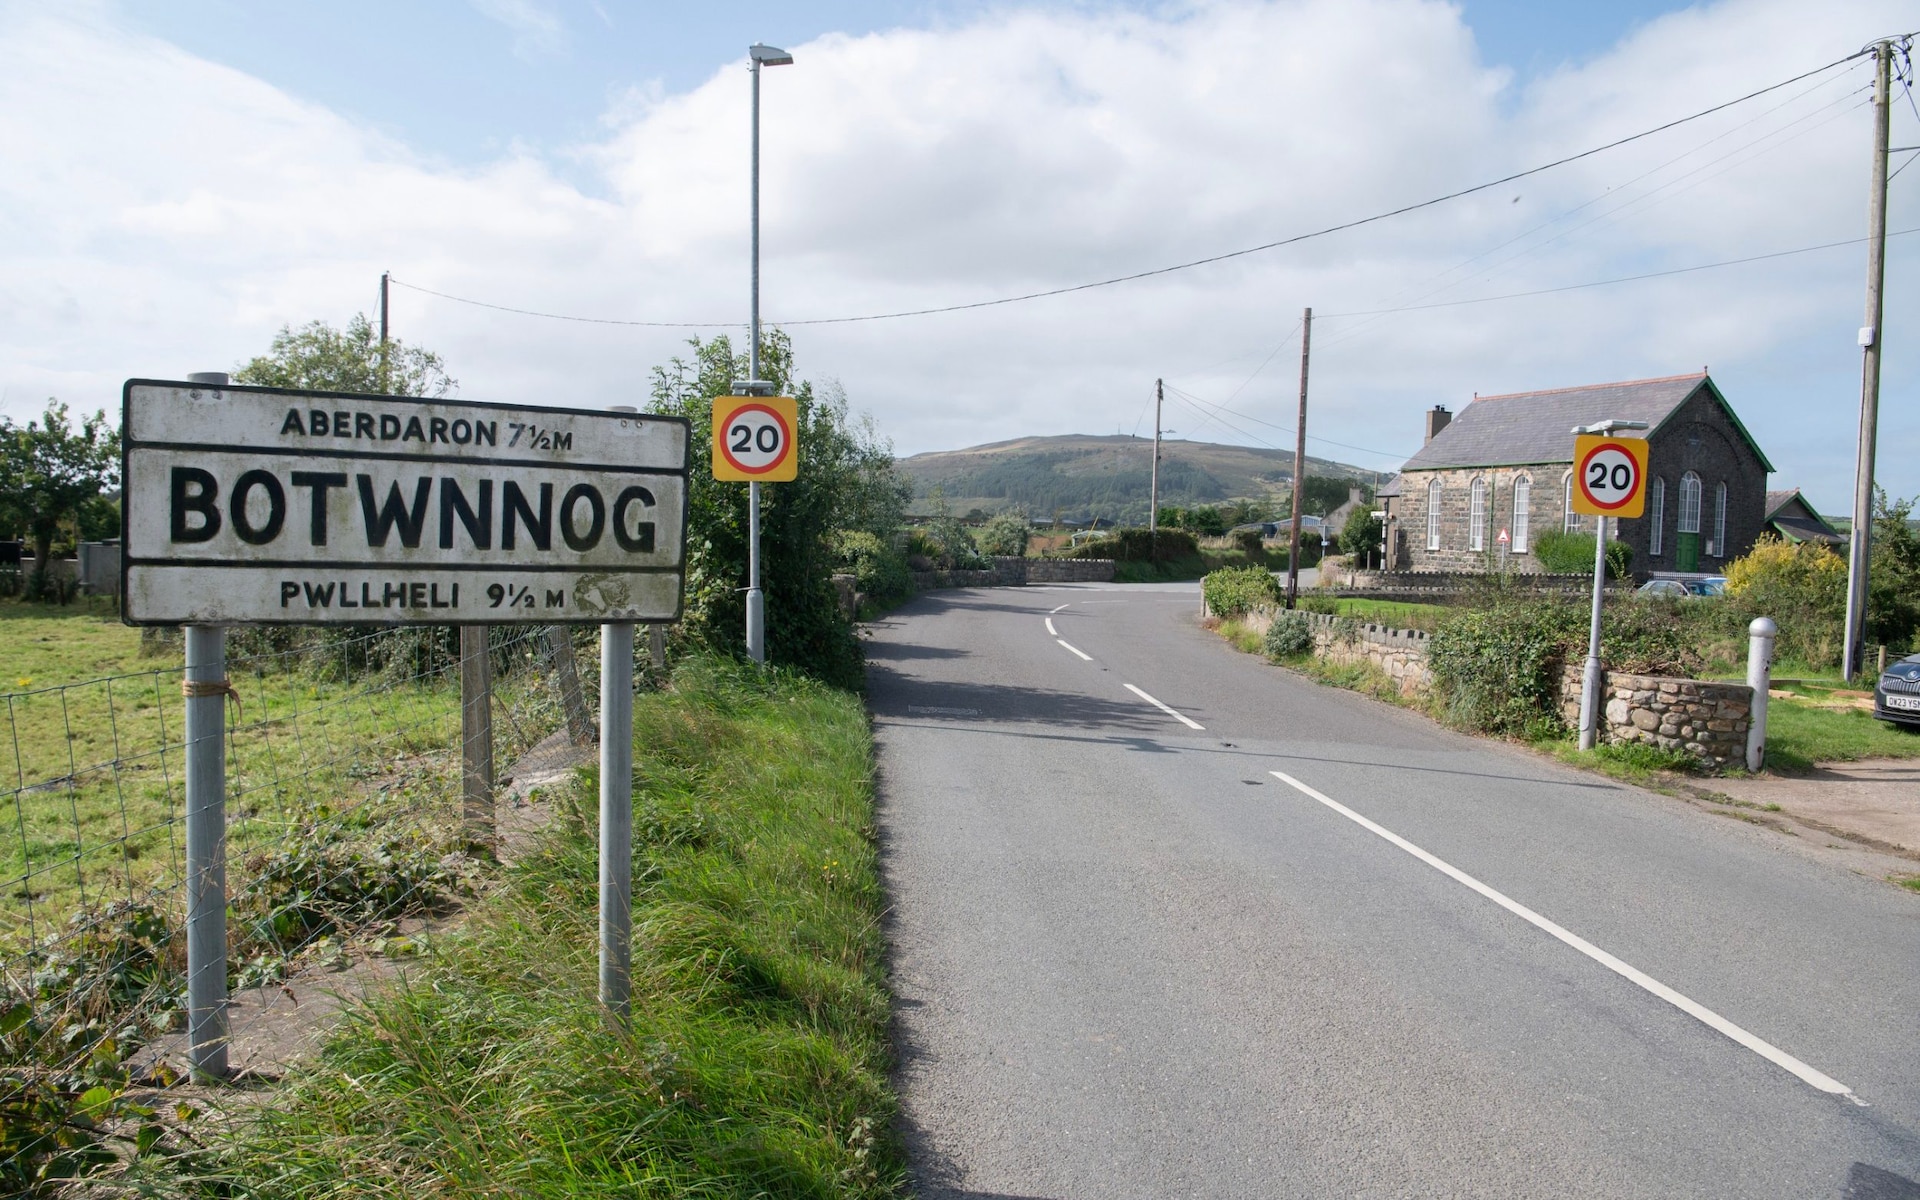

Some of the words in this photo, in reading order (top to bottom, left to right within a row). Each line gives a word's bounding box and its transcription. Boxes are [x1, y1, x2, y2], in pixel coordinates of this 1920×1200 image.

[280, 408, 497, 447] ABERDARON
[731, 425, 779, 453] 20
[1589, 462, 1631, 490] 20
[170, 466, 657, 554] BOTWNNOG
[281, 581, 459, 608] PWLLHELI
[545, 589, 565, 608] M
